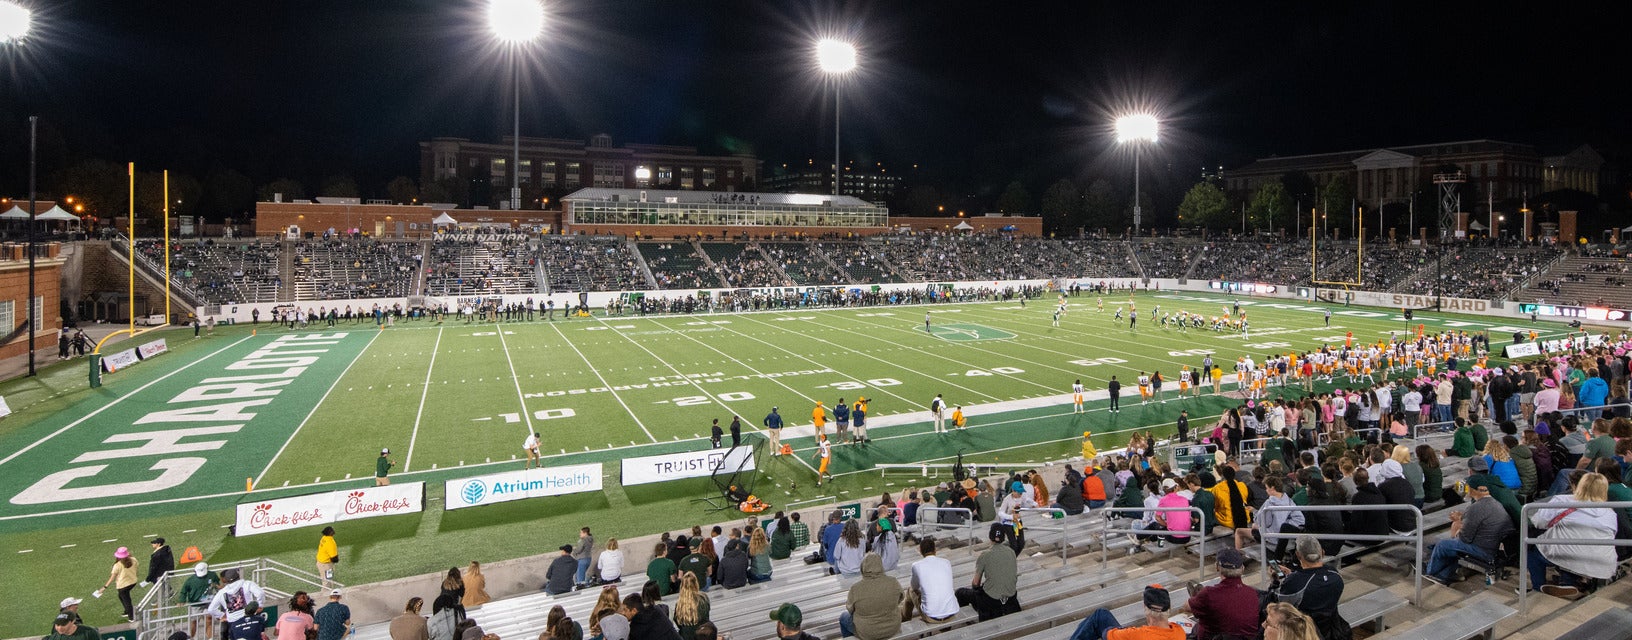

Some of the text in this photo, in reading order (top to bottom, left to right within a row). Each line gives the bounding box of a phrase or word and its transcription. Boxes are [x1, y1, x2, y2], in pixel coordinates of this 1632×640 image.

[1318, 289, 1356, 302] GOLD
[1392, 295, 1487, 312] STANDARD
[965, 366, 1026, 377] 40
[829, 378, 904, 391] 30
[672, 391, 757, 407] 20
[9, 332, 349, 505] CHARLOTTE
[497, 408, 577, 423] 10
[654, 458, 705, 474] TRUIST
[492, 472, 591, 496] Atrium Health
[345, 491, 410, 515] Chick-fil-A
[250, 504, 323, 529] Chick-fil-A
